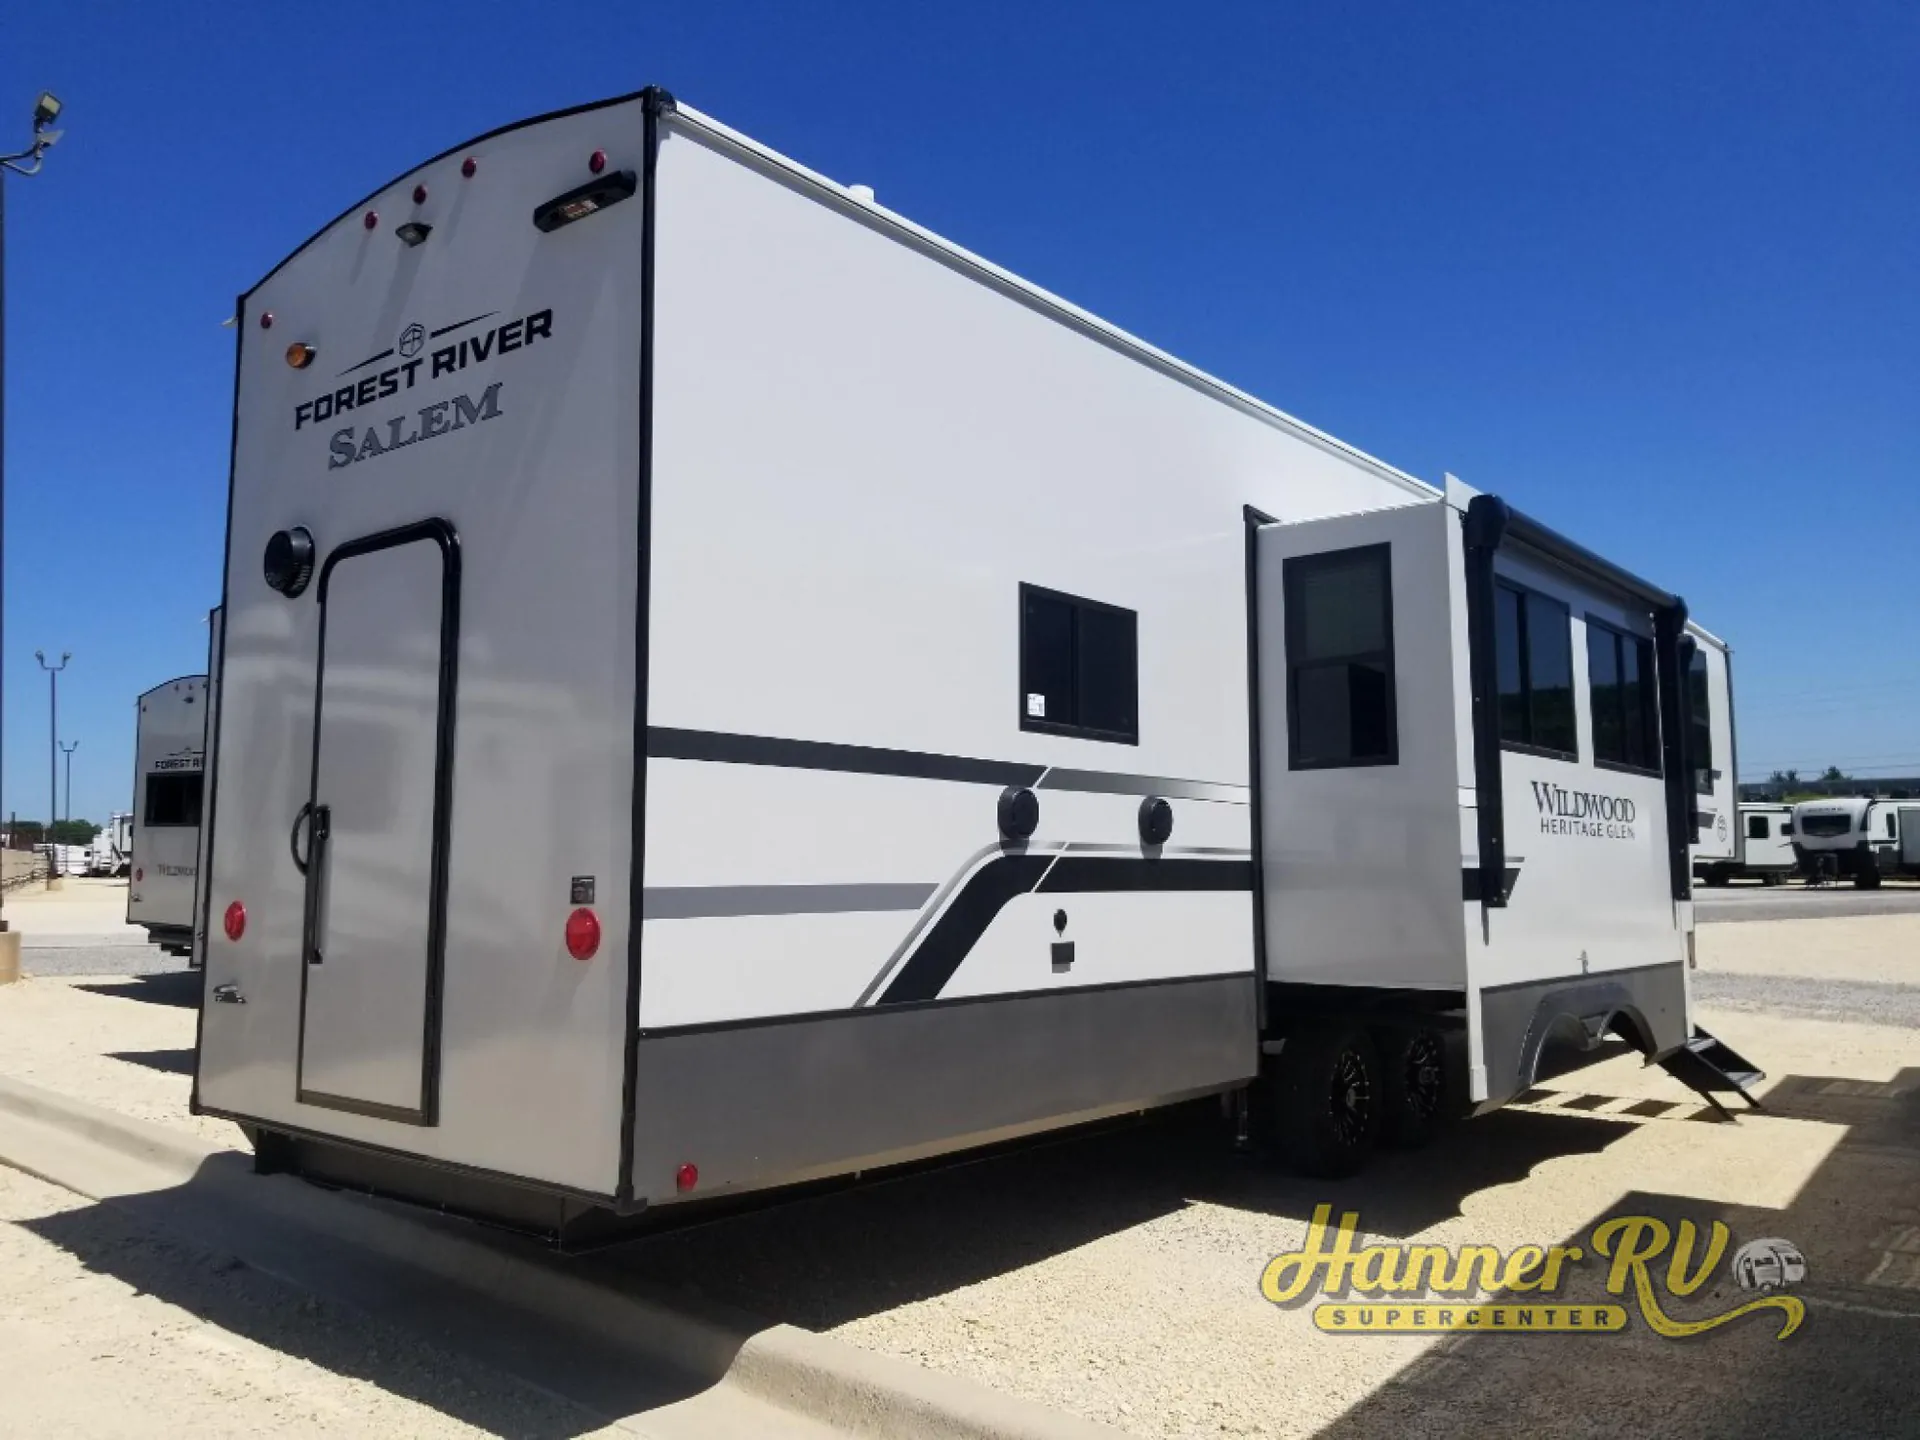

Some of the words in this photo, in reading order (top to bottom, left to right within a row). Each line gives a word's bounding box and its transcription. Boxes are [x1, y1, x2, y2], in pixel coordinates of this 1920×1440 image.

[295, 357, 424, 431] FOREST
[431, 308, 553, 379] RIVER
[328, 382, 503, 471] SALEM
[1531, 780, 1635, 823] WILDWOOD
[1540, 817, 1604, 837] HERITAGE
[1606, 824, 1635, 839] GLEN
